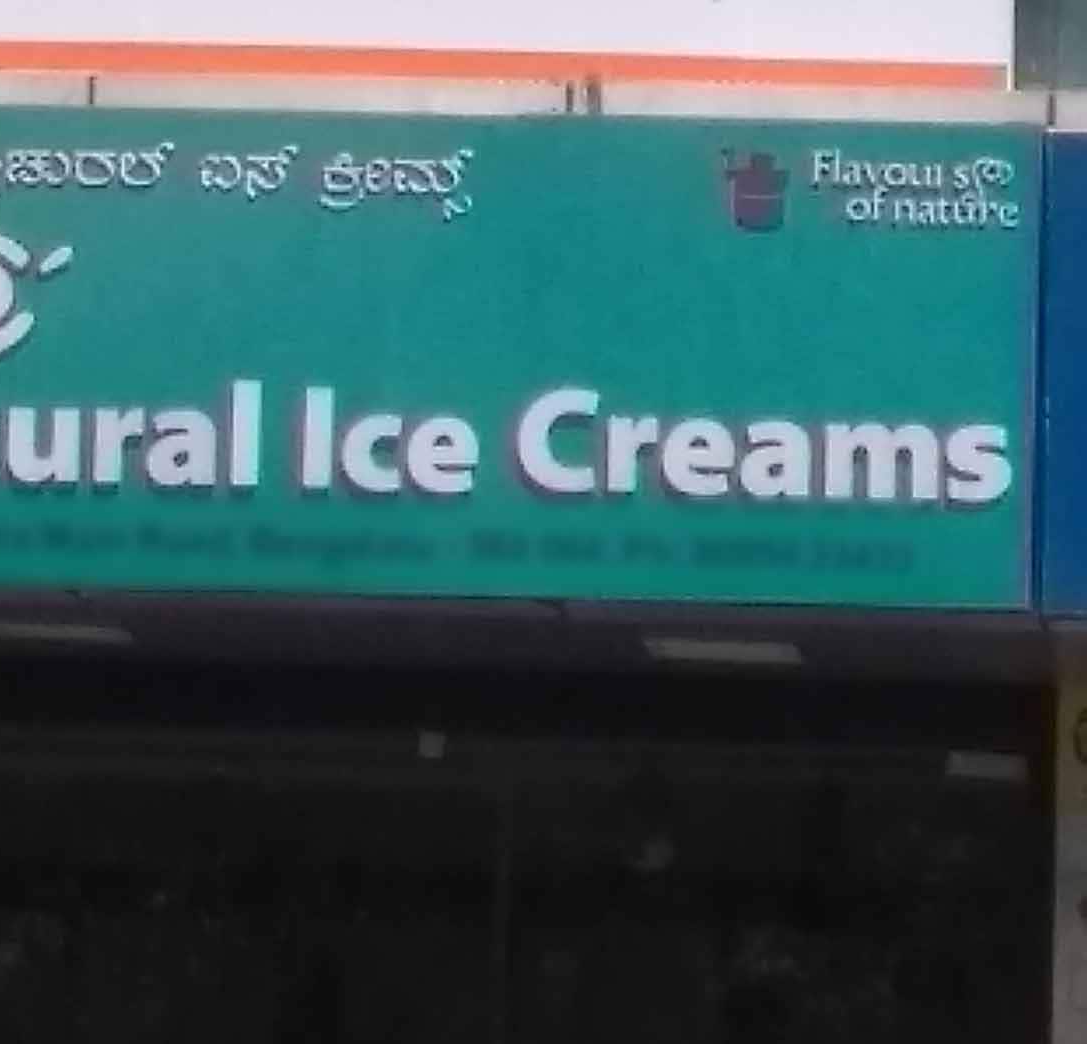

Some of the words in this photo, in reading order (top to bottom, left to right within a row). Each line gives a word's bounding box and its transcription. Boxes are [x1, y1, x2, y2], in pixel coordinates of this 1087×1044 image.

[845, 188, 886, 223] of
[893, 196, 1020, 229] nature
[300, 386, 480, 495] Ice
[517, 388, 1013, 502] Creams
